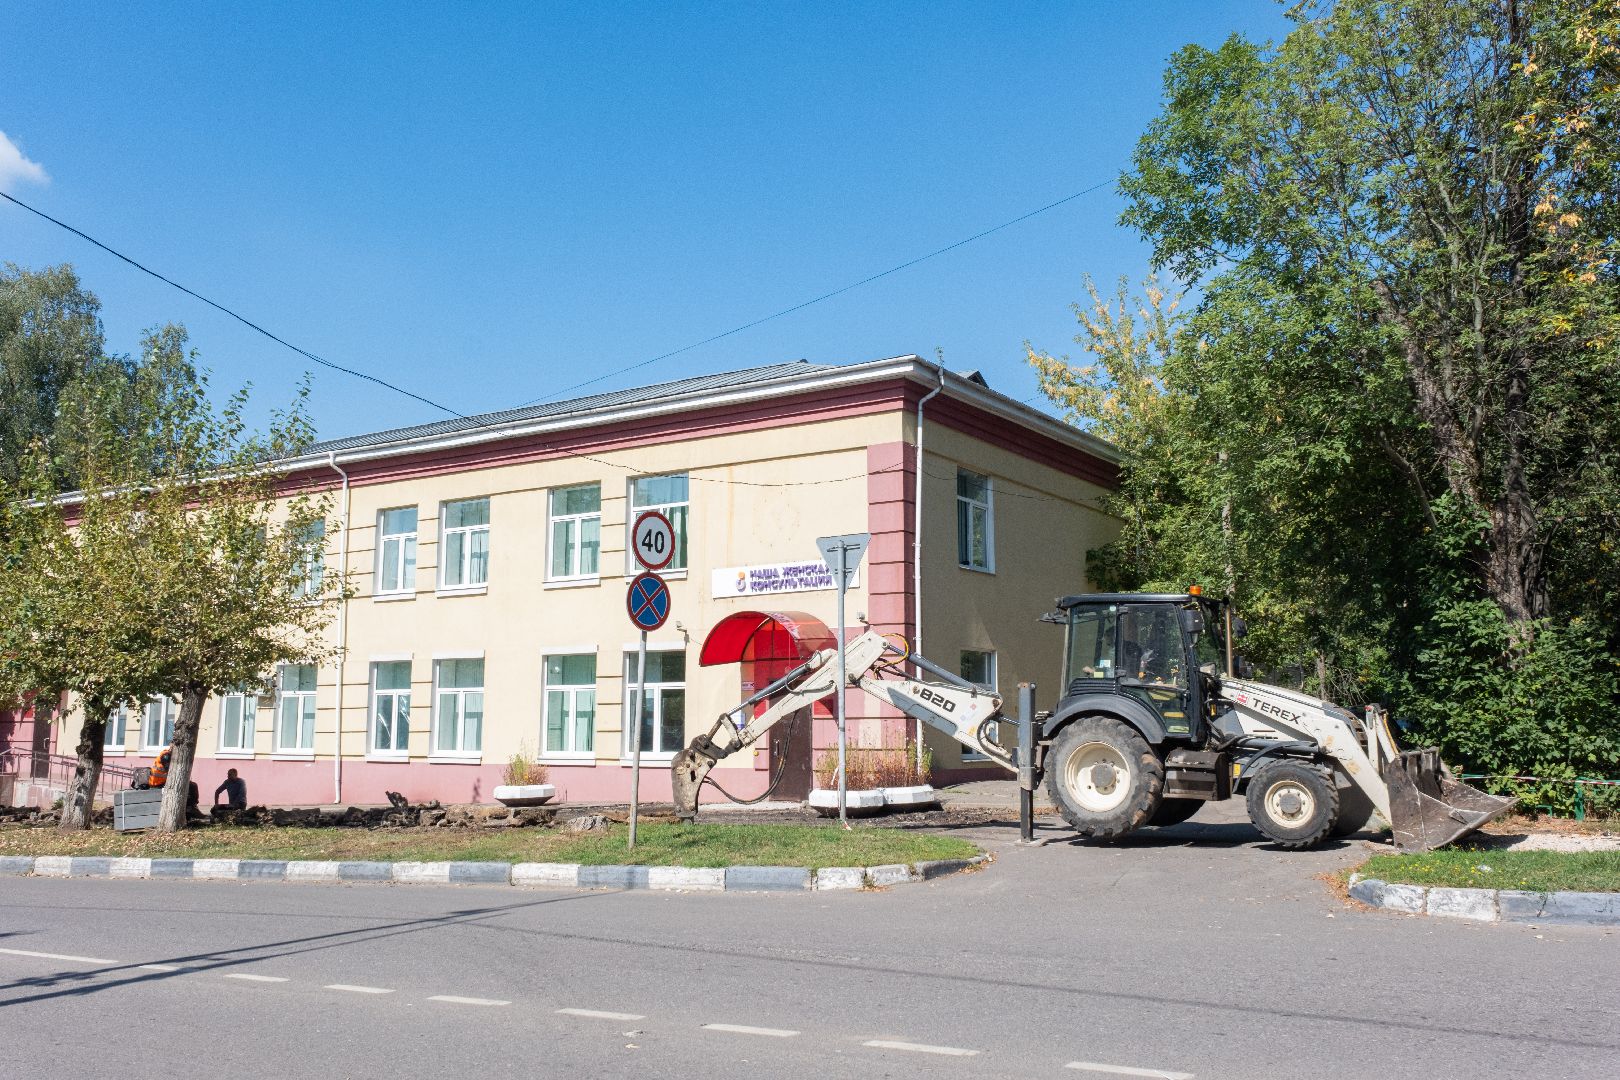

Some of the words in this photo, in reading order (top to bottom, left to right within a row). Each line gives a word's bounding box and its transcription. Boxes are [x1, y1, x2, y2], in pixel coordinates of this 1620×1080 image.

[641, 529, 664, 554] 40
[750, 568, 780, 580] НАША
[750, 575, 832, 592] КОНСУЛЬТАЦИЯ
[920, 688, 956, 712] 820
[1253, 698, 1301, 724] TEREX
